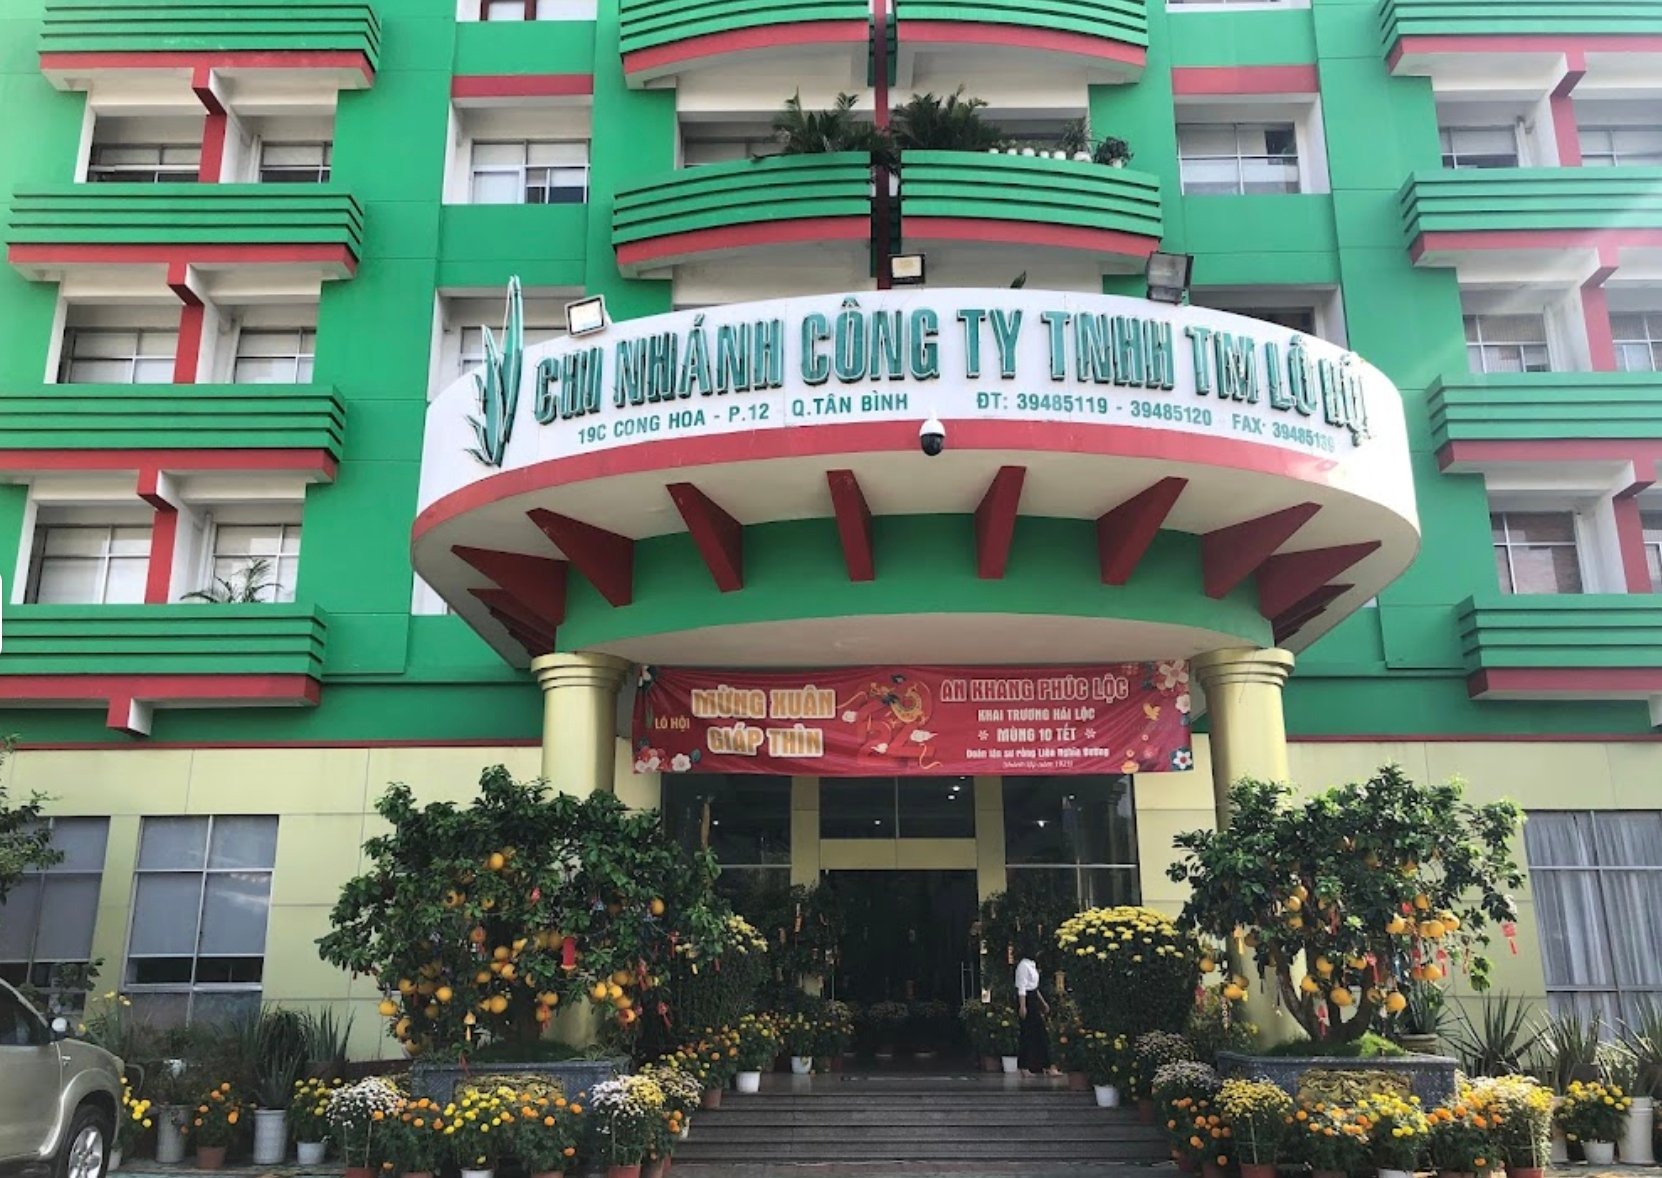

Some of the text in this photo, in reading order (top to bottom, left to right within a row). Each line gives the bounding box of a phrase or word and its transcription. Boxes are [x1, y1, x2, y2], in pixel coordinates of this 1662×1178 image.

[534, 346, 604, 424] CHI
[614, 314, 784, 407] NHÁNH
[800, 297, 940, 385] CÔNG
[957, 308, 1024, 380] TY
[1040, 310, 1175, 390] TNHH
[1185, 325, 1260, 404] TM
[1265, 334, 1317, 416] LÔ
[578, 424, 606, 444] 19C
[728, 403, 769, 423] P.12
[861, 390, 908, 411] BÌNH
[977, 392, 1008, 410] ĐT:
[1016, 393, 1108, 414] 39485119
[1130, 400, 1213, 426] 39485120
[770, 684, 836, 719] XUÂN
[941, 673, 1129, 704] AN KHANG PHÚC LỘC
[670, 717, 690, 733] HỘI
[978, 709, 1004, 721] KHAI
[1075, 705, 1096, 721] LỘC
[707, 721, 824, 757] GIÁP THÌN
[1039, 728, 1053, 742] 10
[1056, 722, 1077, 741] TẾT
